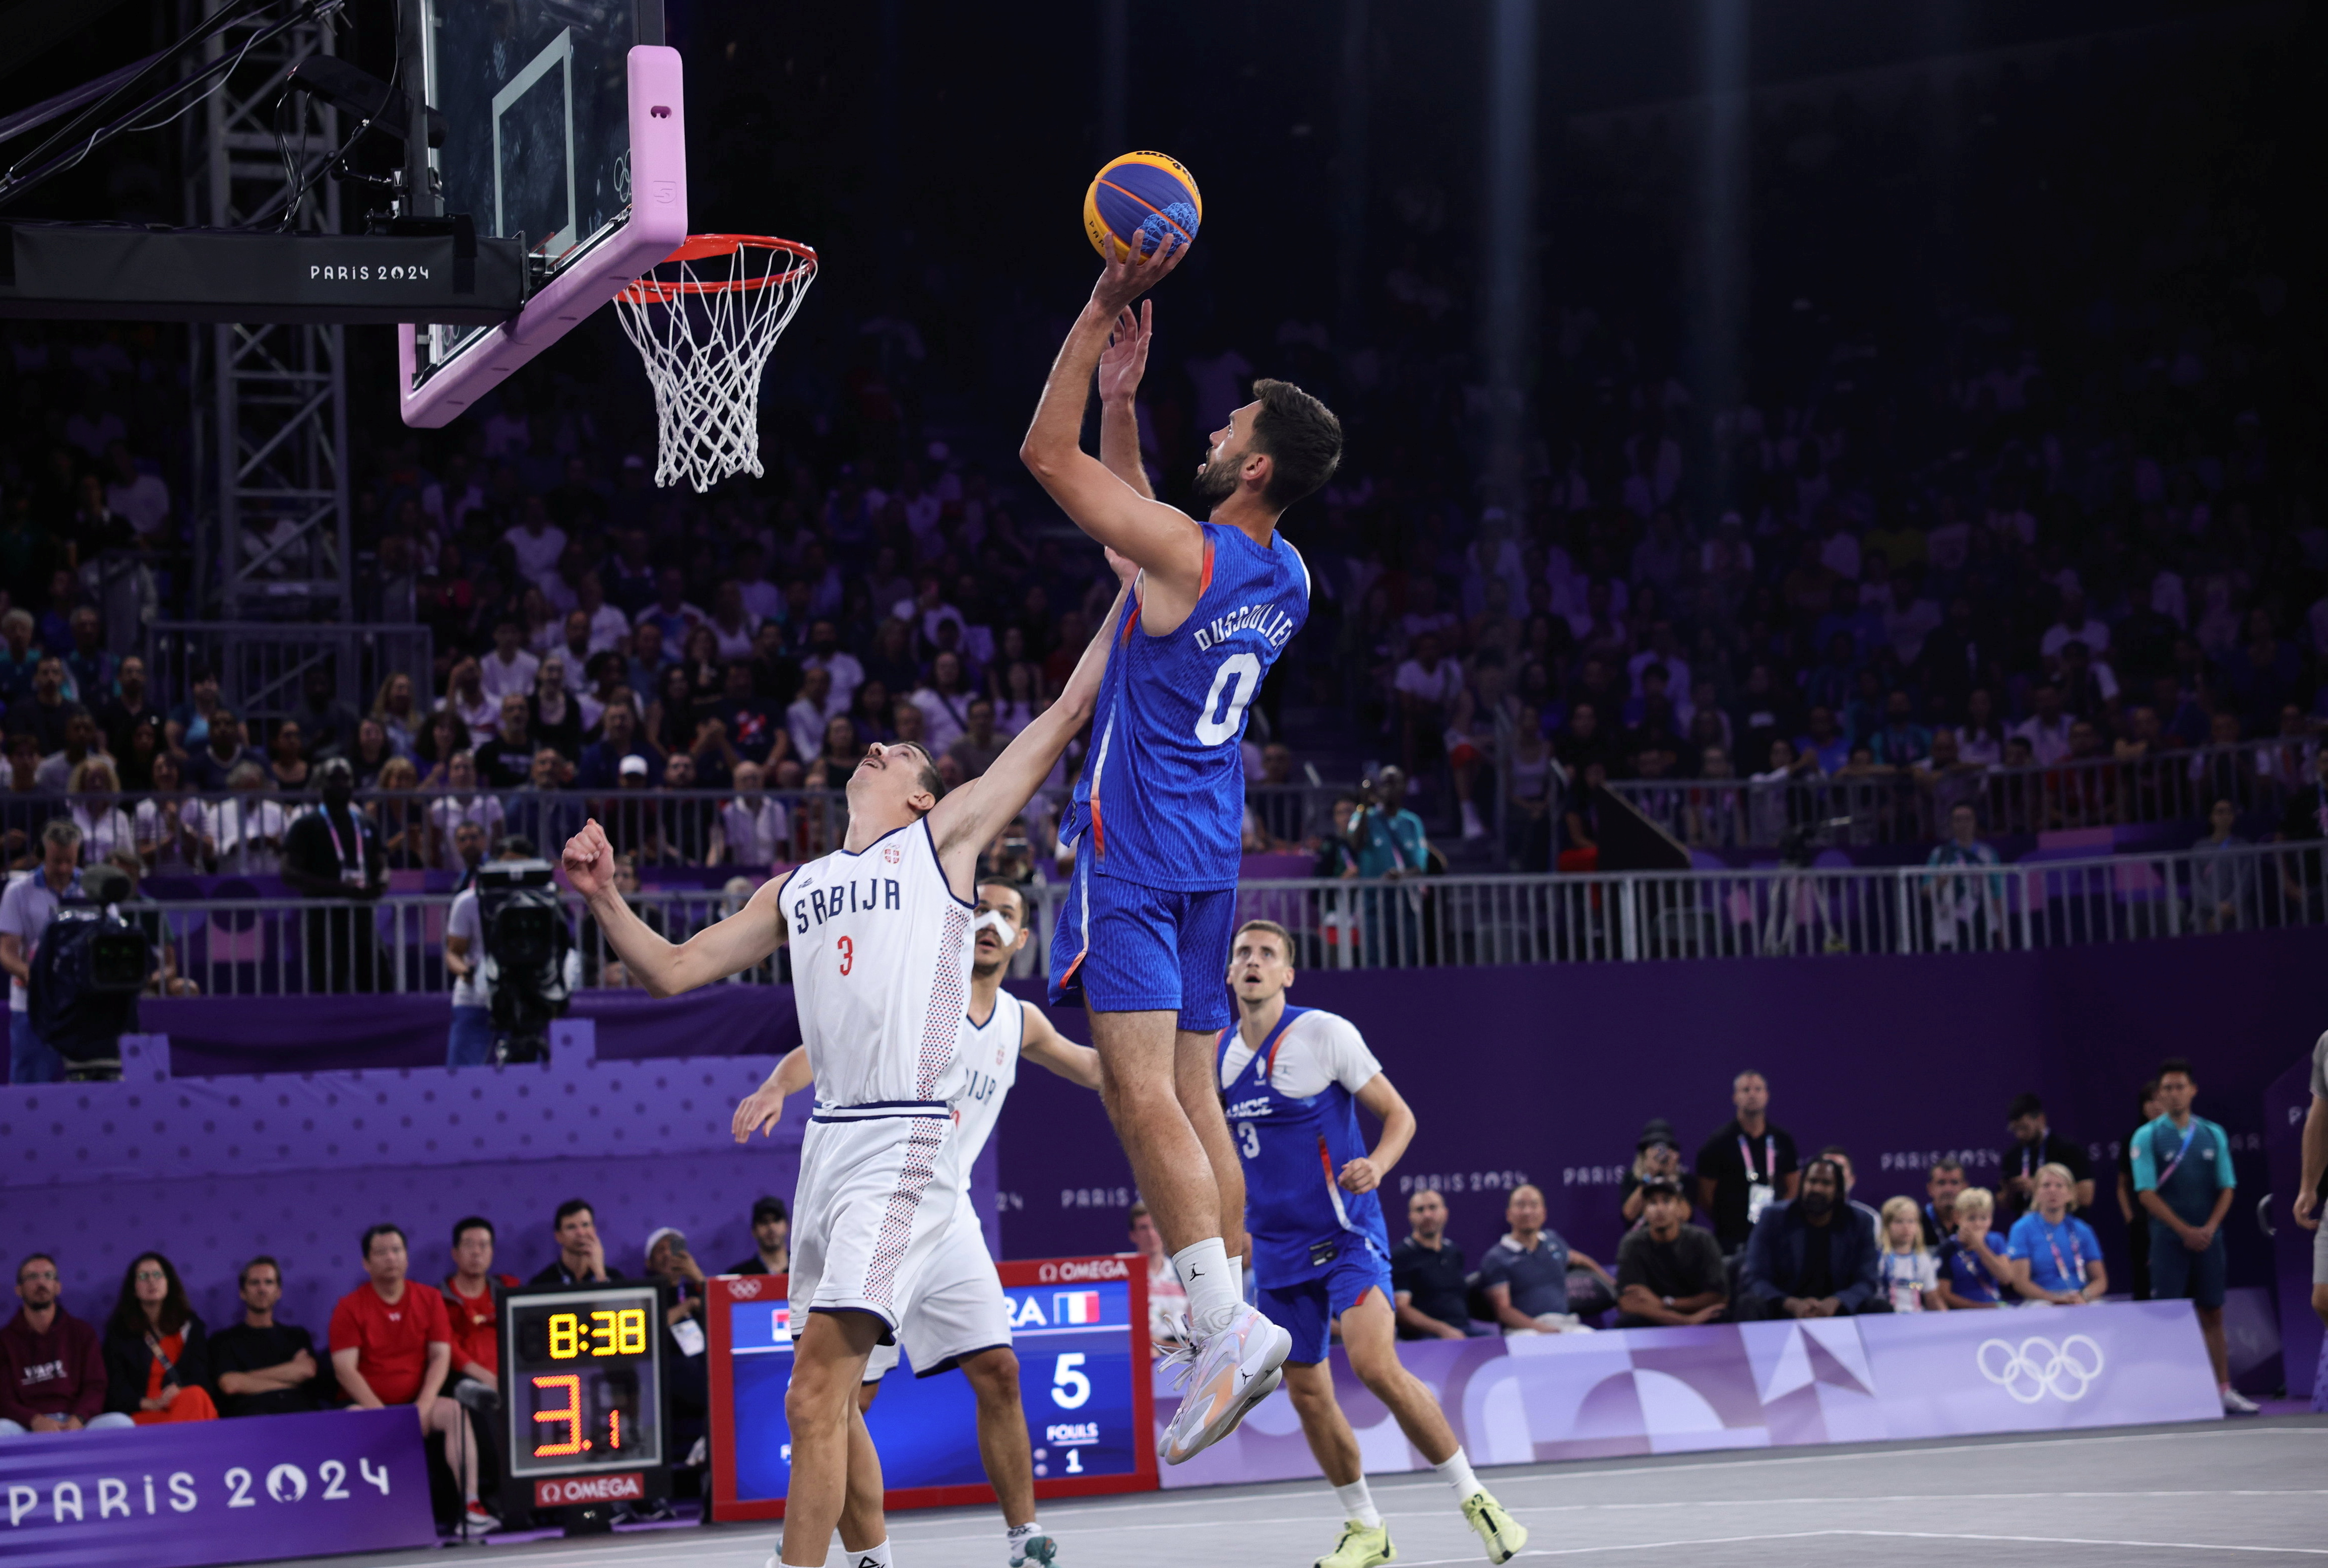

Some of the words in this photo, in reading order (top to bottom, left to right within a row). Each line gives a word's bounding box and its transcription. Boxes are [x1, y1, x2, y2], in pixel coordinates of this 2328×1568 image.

[310, 266, 369, 280] PARIS
[378, 266, 428, 280] 2024
[1194, 653, 1261, 746] 0
[795, 878, 900, 935] SRBIJA
[837, 935, 853, 976] 3
[966, 1068, 997, 1105] IJA
[1237, 1122, 1261, 1159] 3
[1059, 1260, 1129, 1280] OMEGA
[1003, 1295, 1047, 1327] RA
[549, 1309, 646, 1359] 8:38
[1051, 1352, 1091, 1409] 5
[1046, 1422, 1099, 1441] FOULS
[1065, 1448, 1084, 1473] 1
[8, 1472, 197, 1526] PARIS
[224, 1458, 390, 1508] 2024
[564, 1476, 639, 1500] OMEGA
